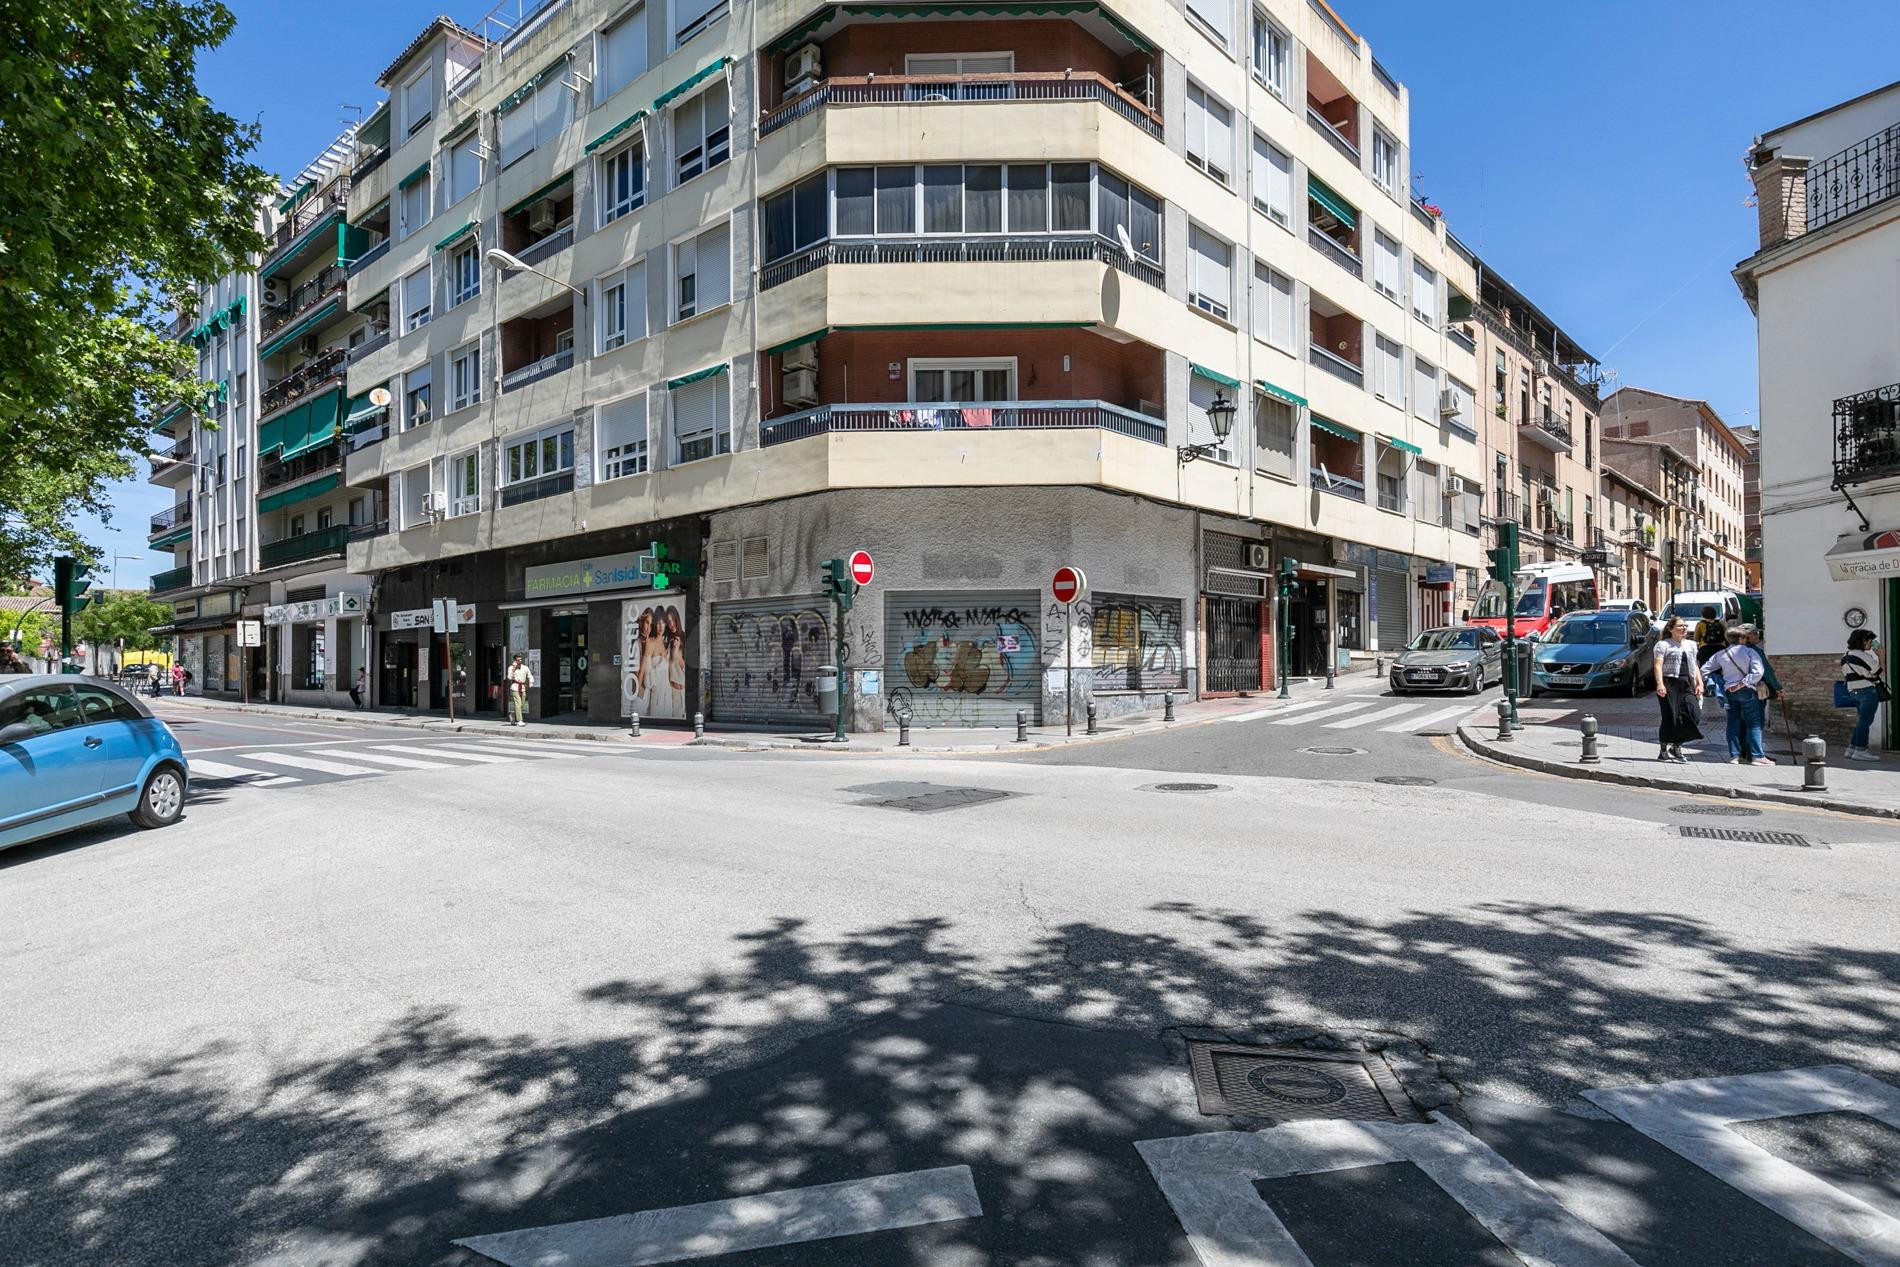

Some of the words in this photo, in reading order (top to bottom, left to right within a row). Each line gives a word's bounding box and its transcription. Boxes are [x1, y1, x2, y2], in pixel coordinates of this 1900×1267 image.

[1849, 562, 1877, 575] gracia
[1879, 560, 1890, 570] de
[527, 574, 580, 592] FARMACIA
[414, 614, 430, 626] SAN
